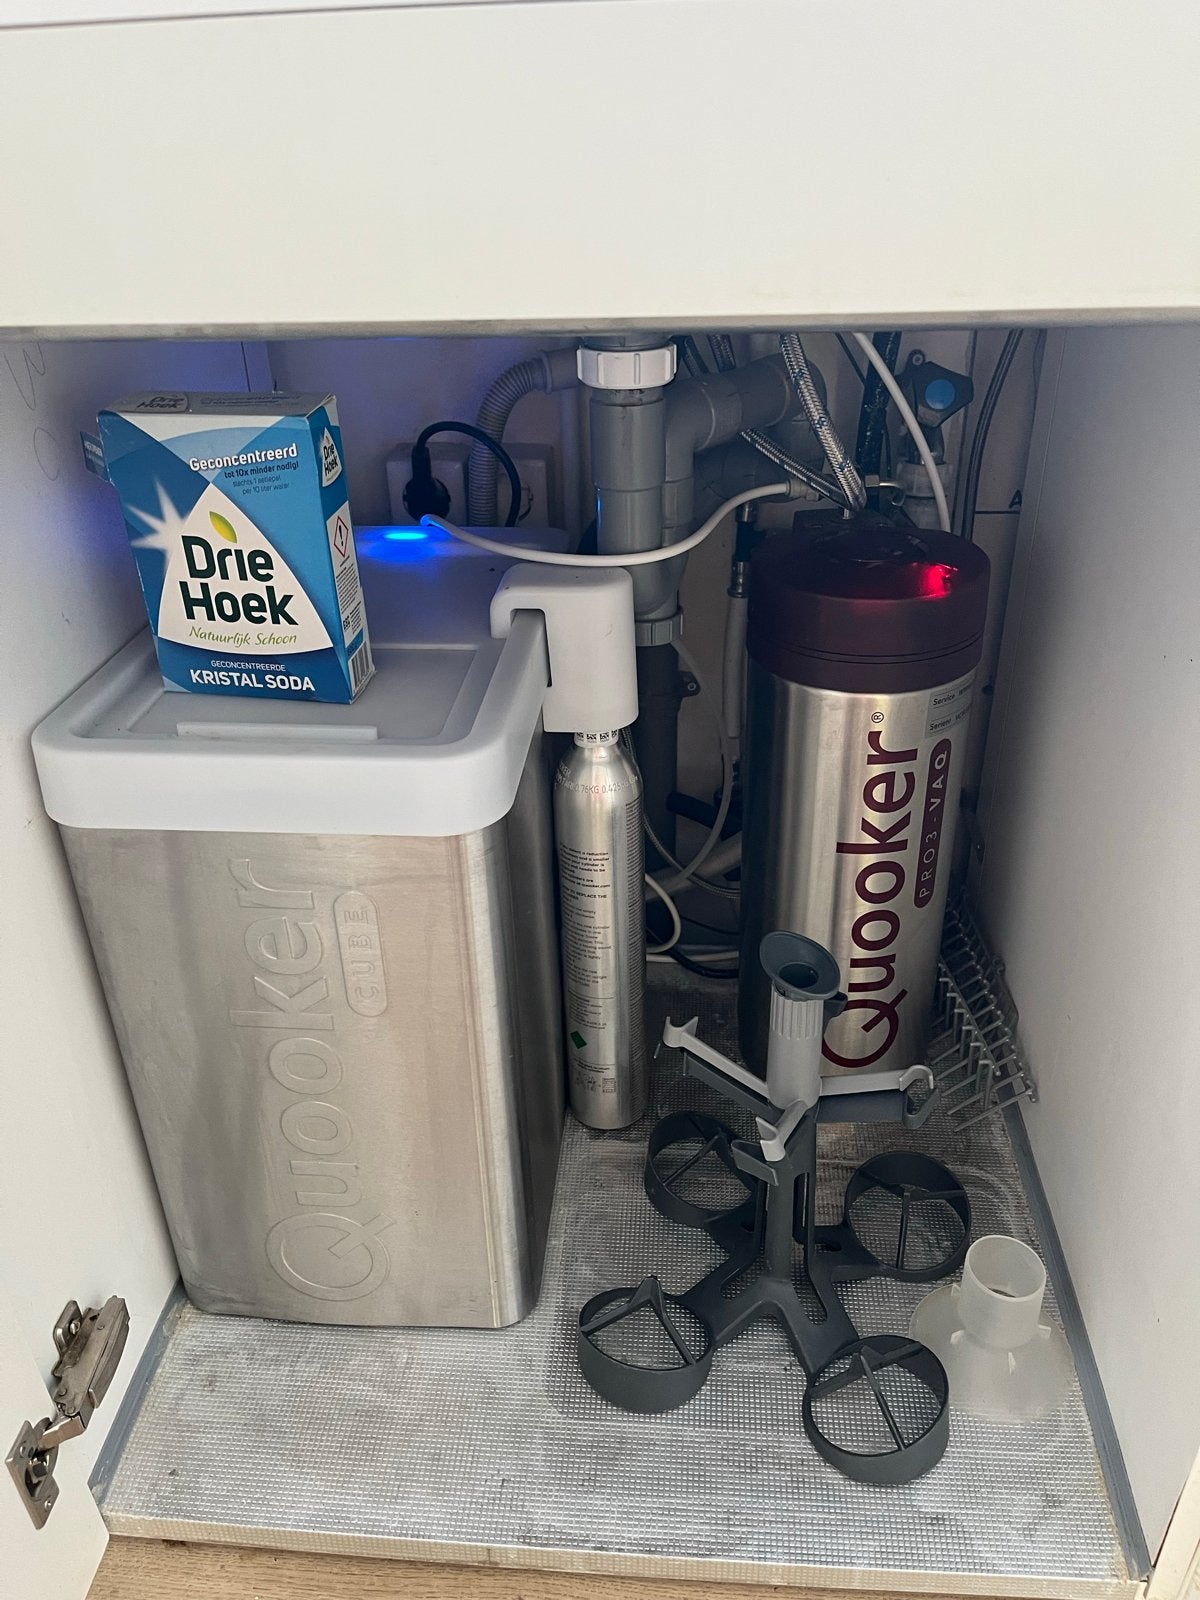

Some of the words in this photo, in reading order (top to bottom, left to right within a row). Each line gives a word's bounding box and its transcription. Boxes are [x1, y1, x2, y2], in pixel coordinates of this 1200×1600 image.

[189, 443, 298, 471] Geconcentreerd
[323, 455, 339, 476] Hoek
[235, 468, 249, 477] 10x
[250, 466, 275, 475] minder
[181, 535, 274, 583] Drie
[178, 581, 299, 625] Hoek
[189, 626, 251, 648] Natuurlijk
[255, 632, 297, 645] Schoon
[210, 660, 286, 672] GECONCENTREERDE
[189, 669, 264, 688] KRISTAL
[264, 675, 316, 692] SODA
[821, 730, 918, 1068] Quooker
[343, 910, 380, 999] CUBE
[228, 858, 397, 1302] Quooker
